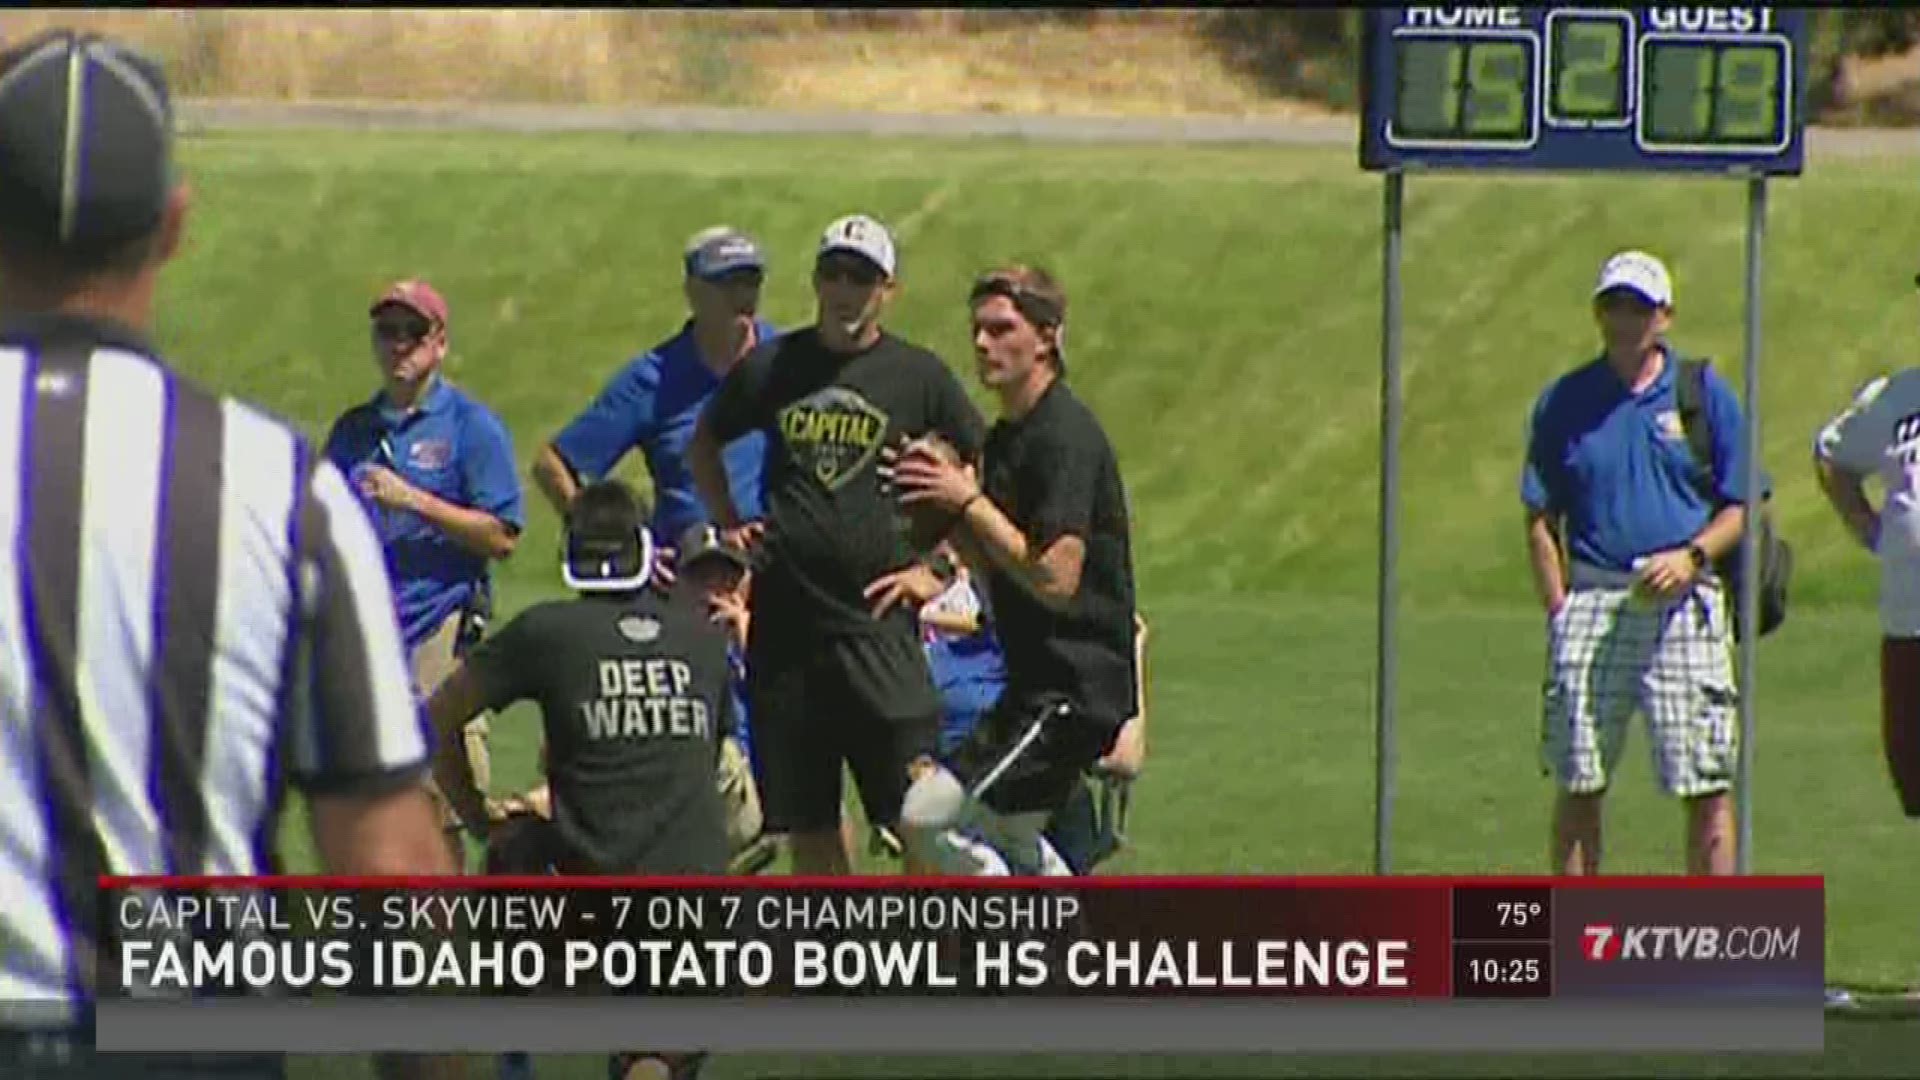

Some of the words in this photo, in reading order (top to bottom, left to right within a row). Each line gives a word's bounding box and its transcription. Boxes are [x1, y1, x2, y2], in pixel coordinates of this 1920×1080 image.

[1444, 42, 1525, 133] 15
[1559, 21, 1622, 114] 2
[787, 410, 878, 447] CAPITAL
[598, 658, 692, 697] DEEP
[581, 698, 711, 742] WATER
